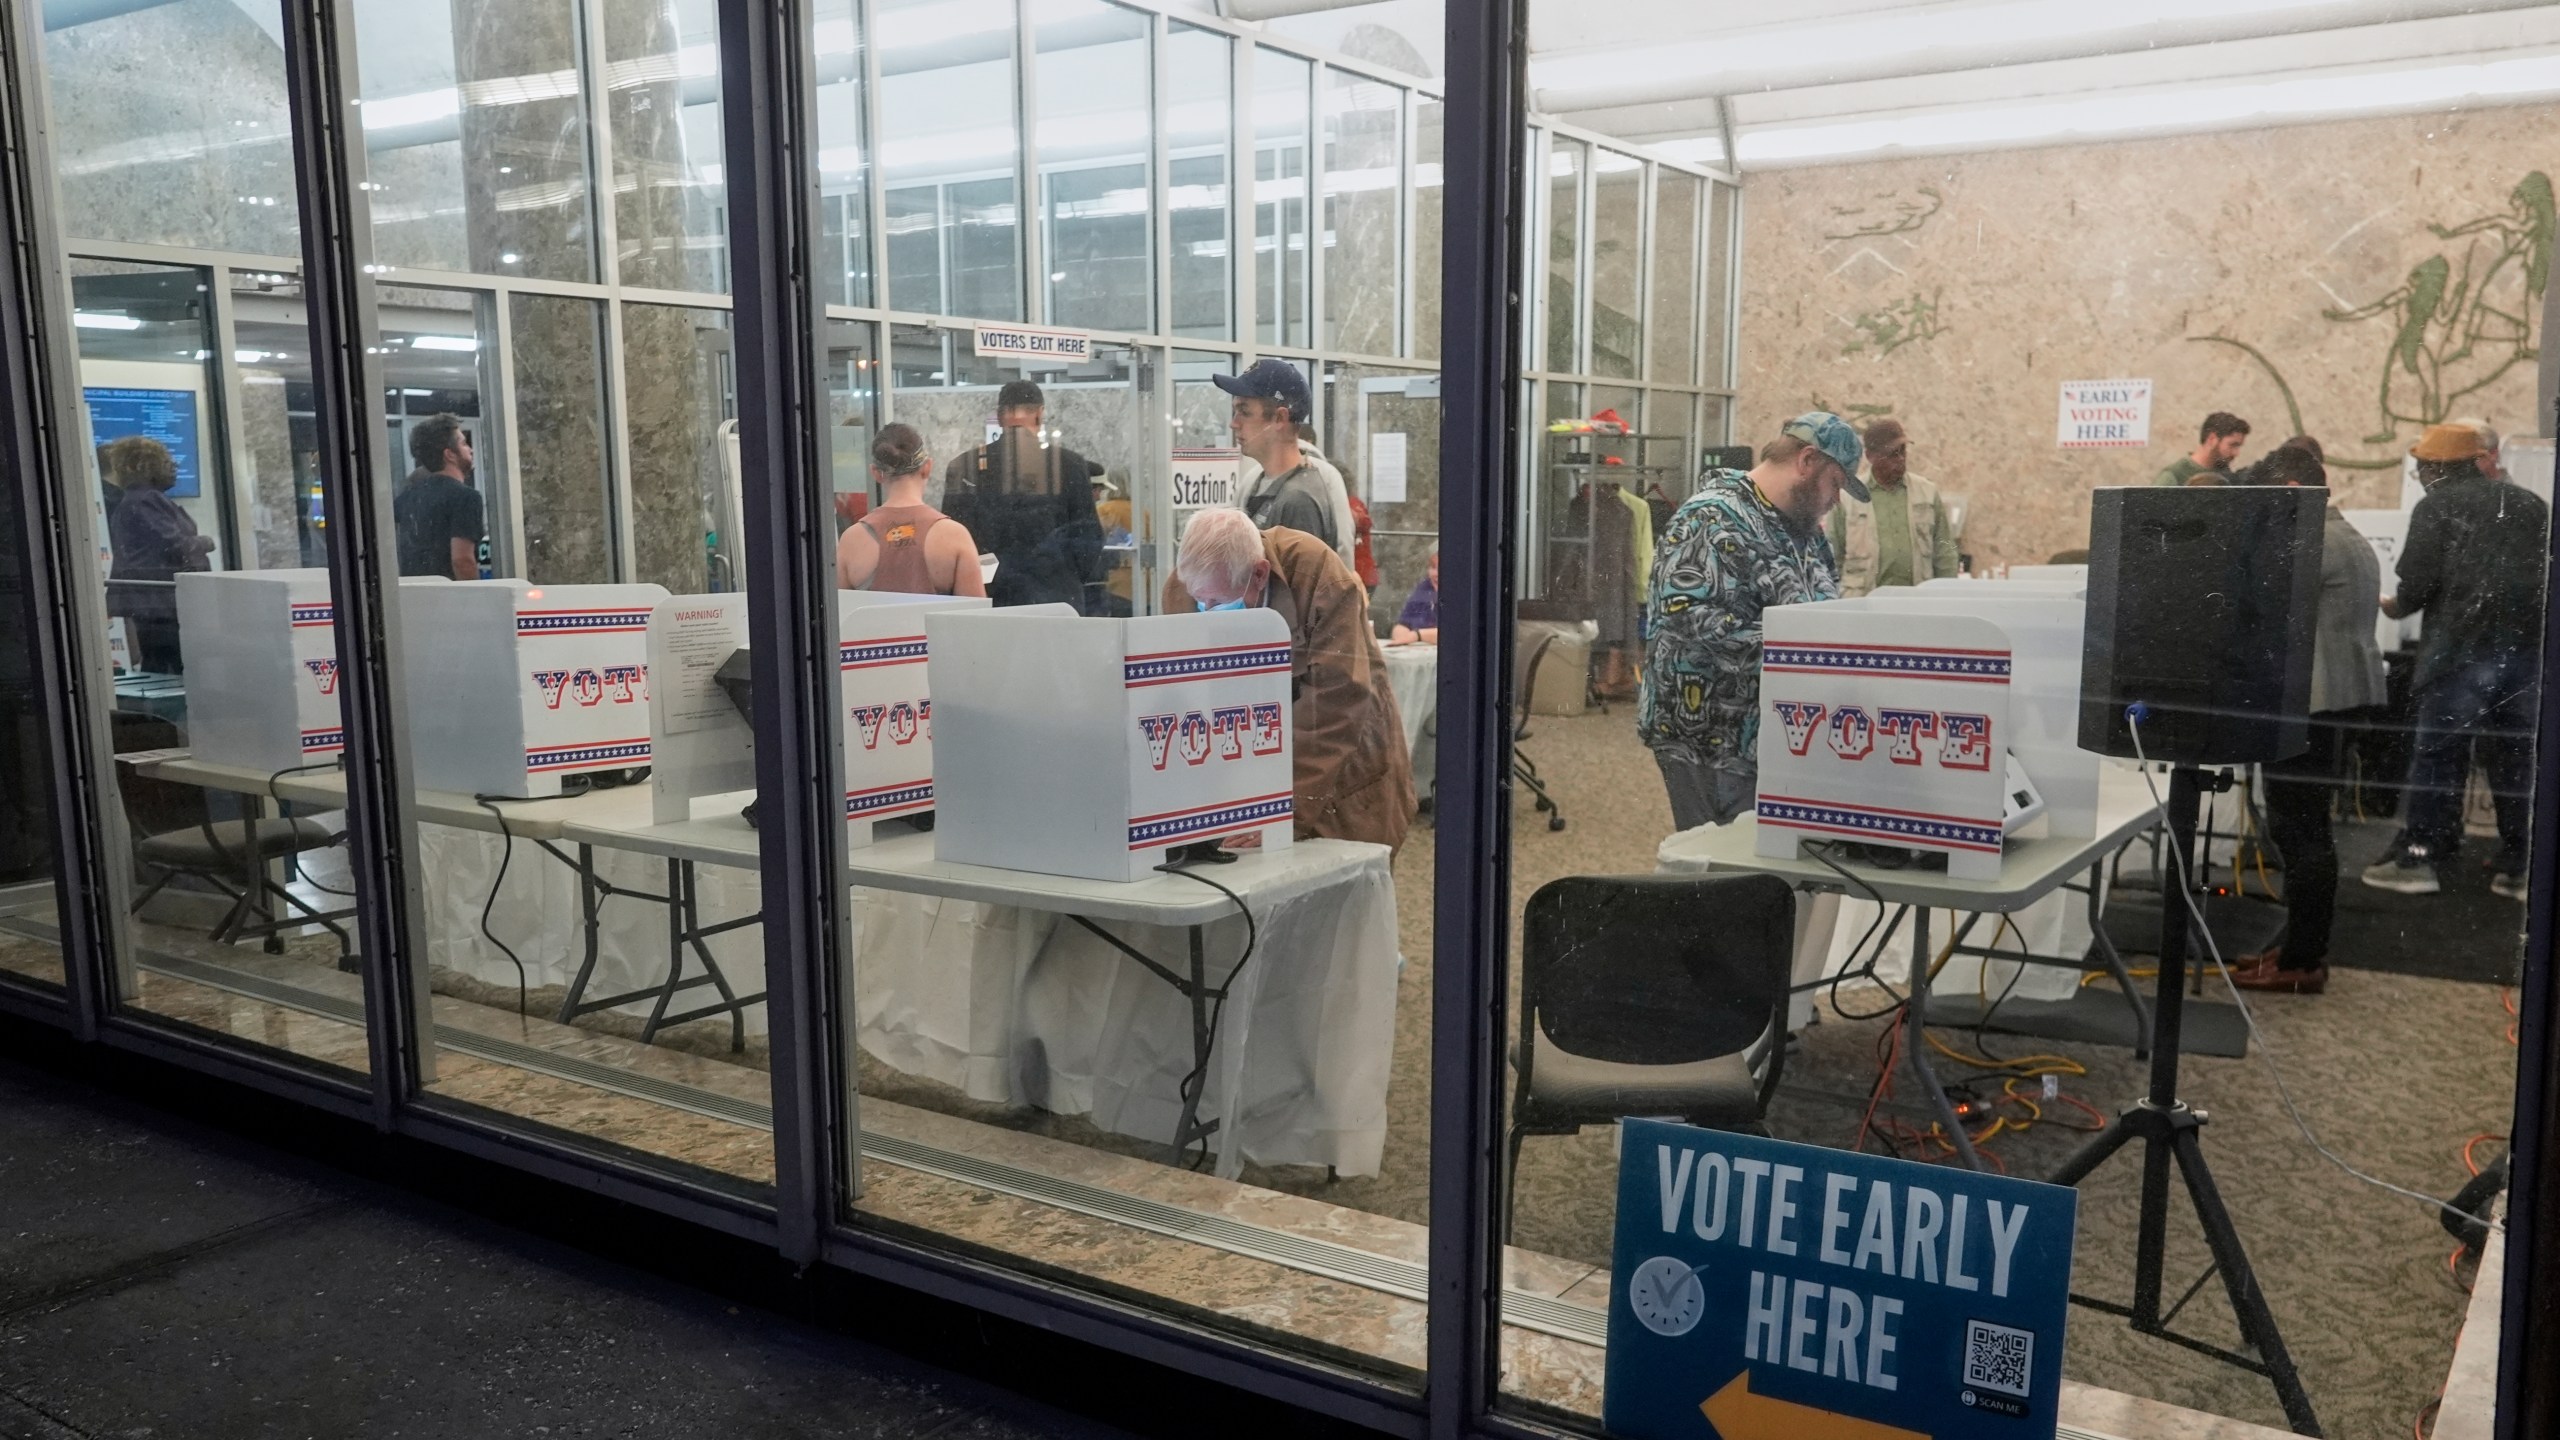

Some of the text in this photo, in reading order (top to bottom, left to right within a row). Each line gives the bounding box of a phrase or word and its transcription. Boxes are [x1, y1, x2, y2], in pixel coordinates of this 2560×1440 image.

[981, 332, 1085, 354] VOTERS EXIT HERE
[2079, 389, 2131, 404] EARLY
[2070, 407, 2138, 421] VOTING
[2077, 424, 2130, 440] HERE
[1173, 472, 1227, 505] Station
[531, 664, 649, 709] VOT
[1138, 702, 1282, 771] VOTE
[1773, 700, 1993, 772] VOTE
[1658, 1144, 2029, 1298] VOTE EARLY
[1745, 1270, 1904, 1391] HERE
[1979, 1397, 2021, 1414] SCAN ME
